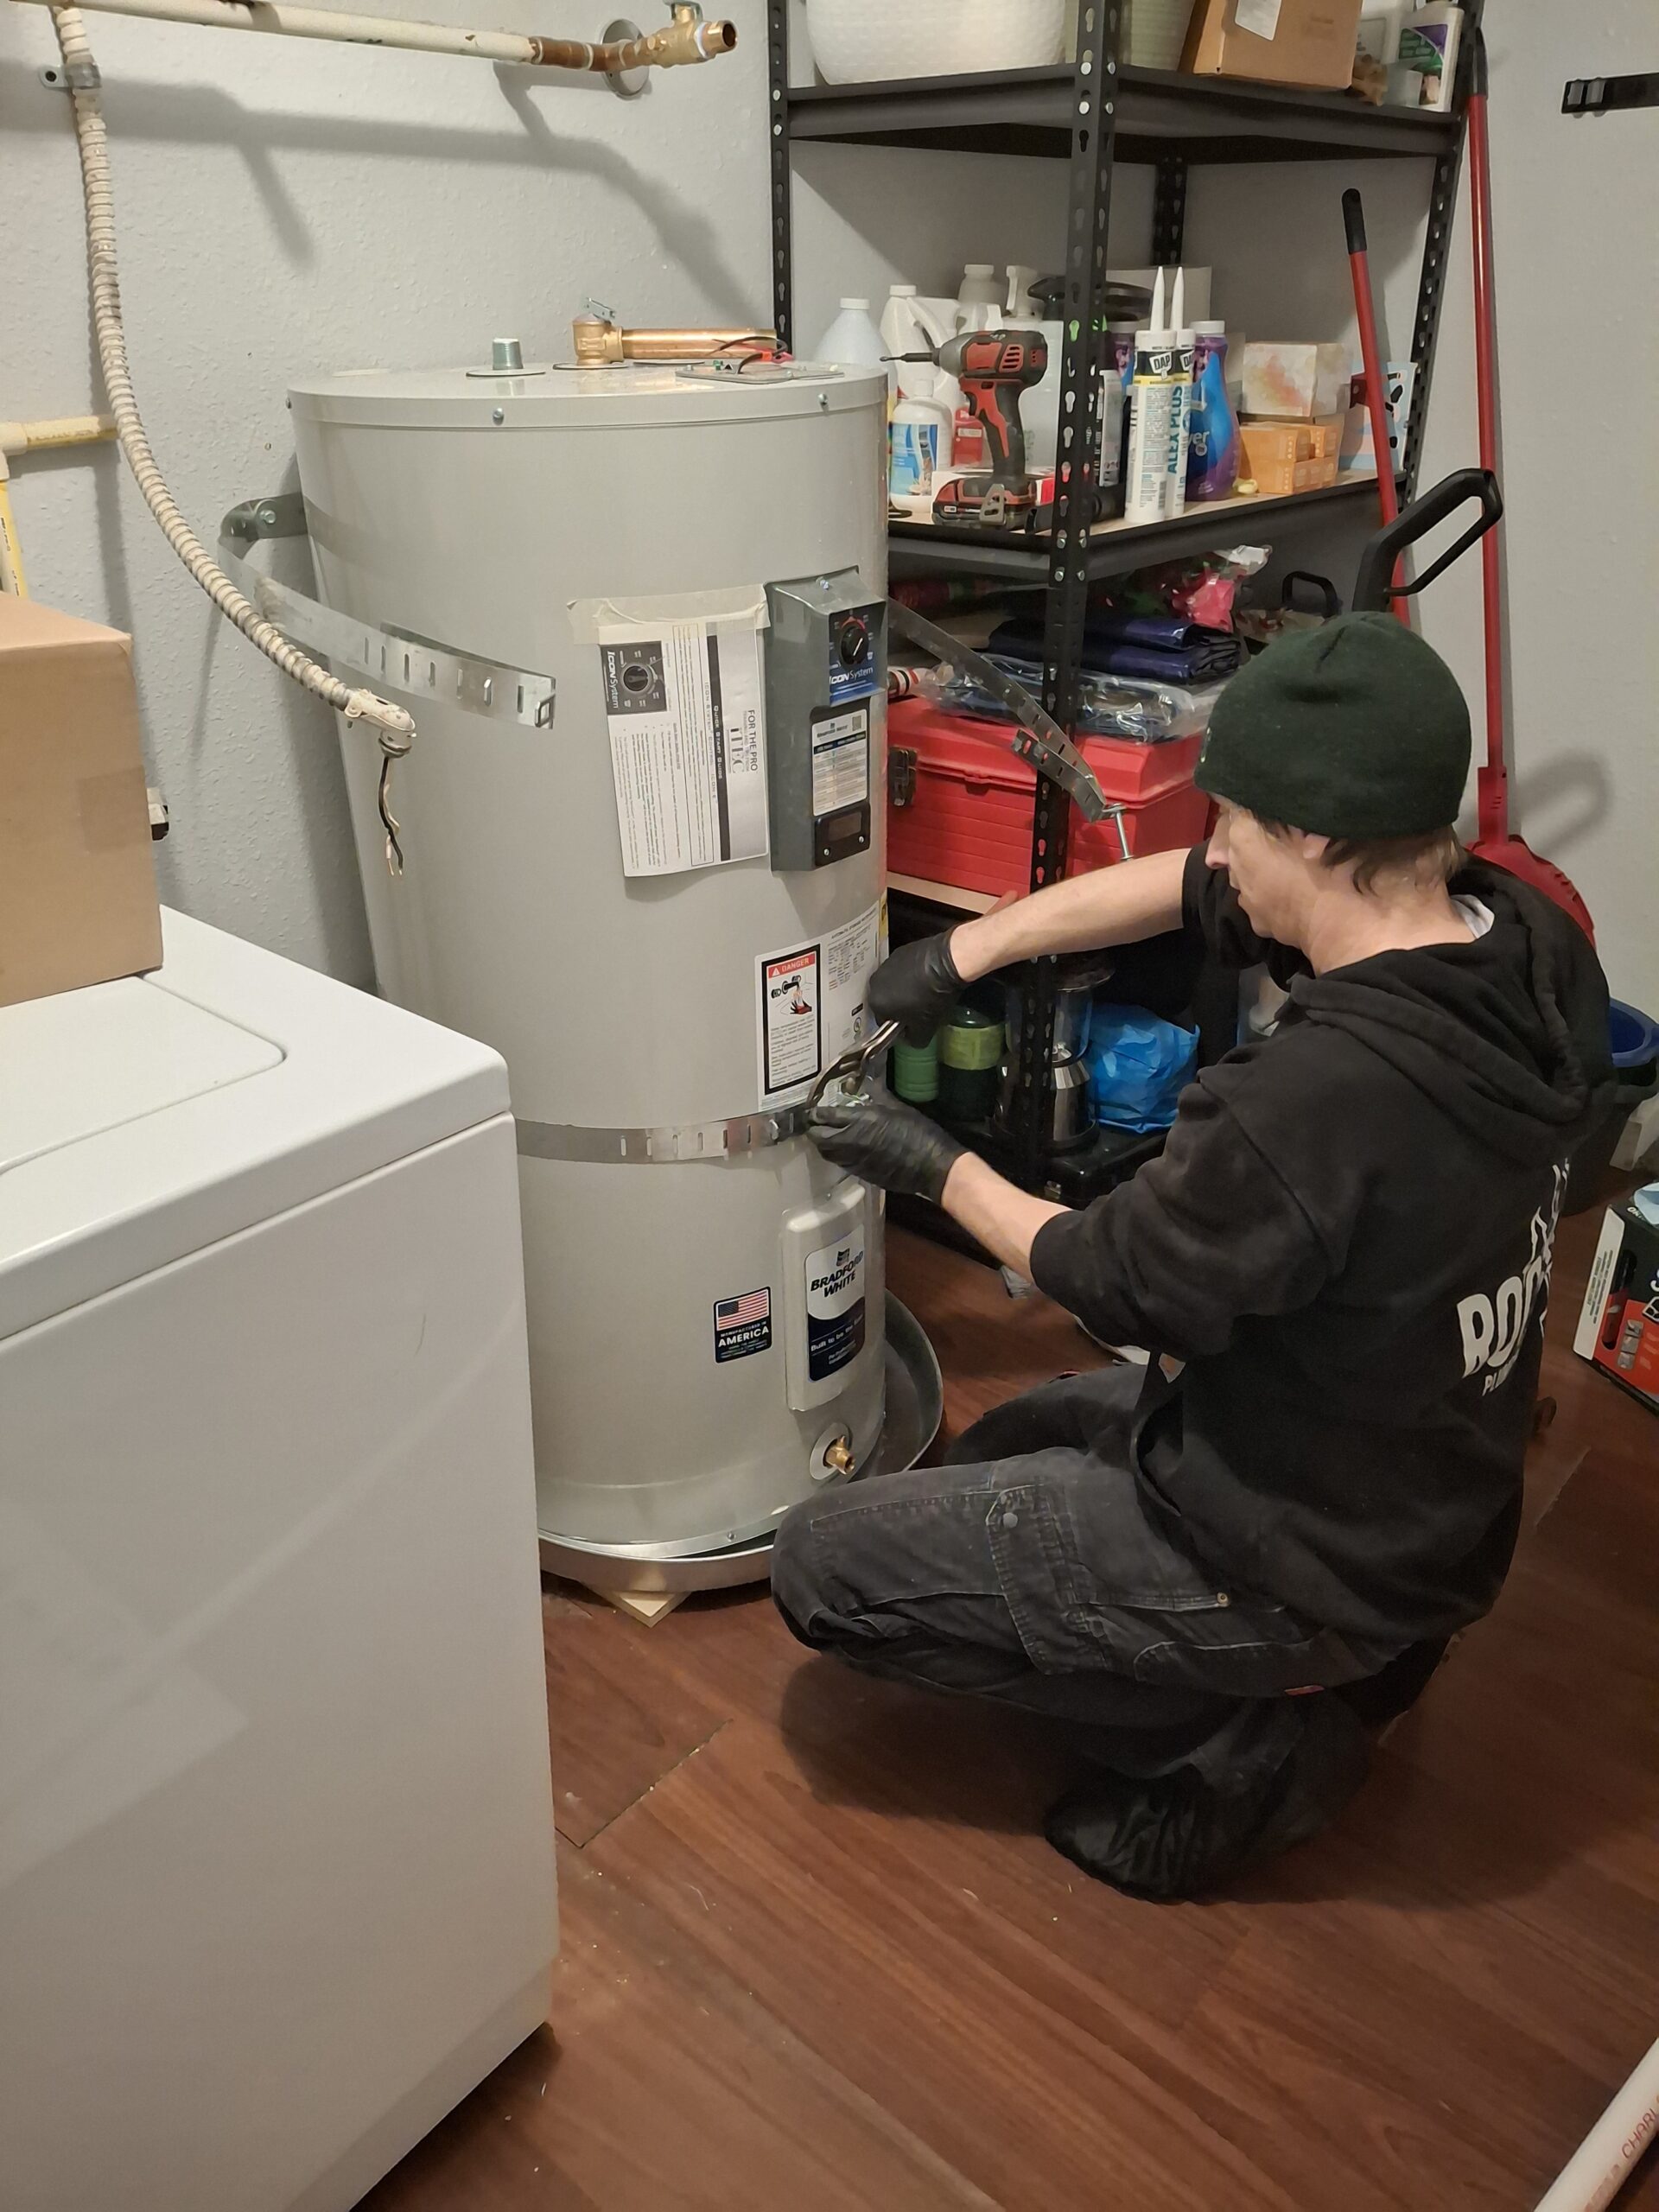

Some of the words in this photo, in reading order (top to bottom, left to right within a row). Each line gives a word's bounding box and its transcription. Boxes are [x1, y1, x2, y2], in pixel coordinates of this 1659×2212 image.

[1154, 355, 1170, 371] DAP
[1170, 385, 1183, 429] PLUS
[1167, 434, 1180, 474] ALEX
[747, 709, 756, 729] FOR
[748, 731, 757, 750] THE
[750, 752, 759, 772] PRO
[781, 957, 810, 973] DANGER
[824, 1270, 855, 1298] WHITE
[718, 1325, 769, 1348] AMERICA
